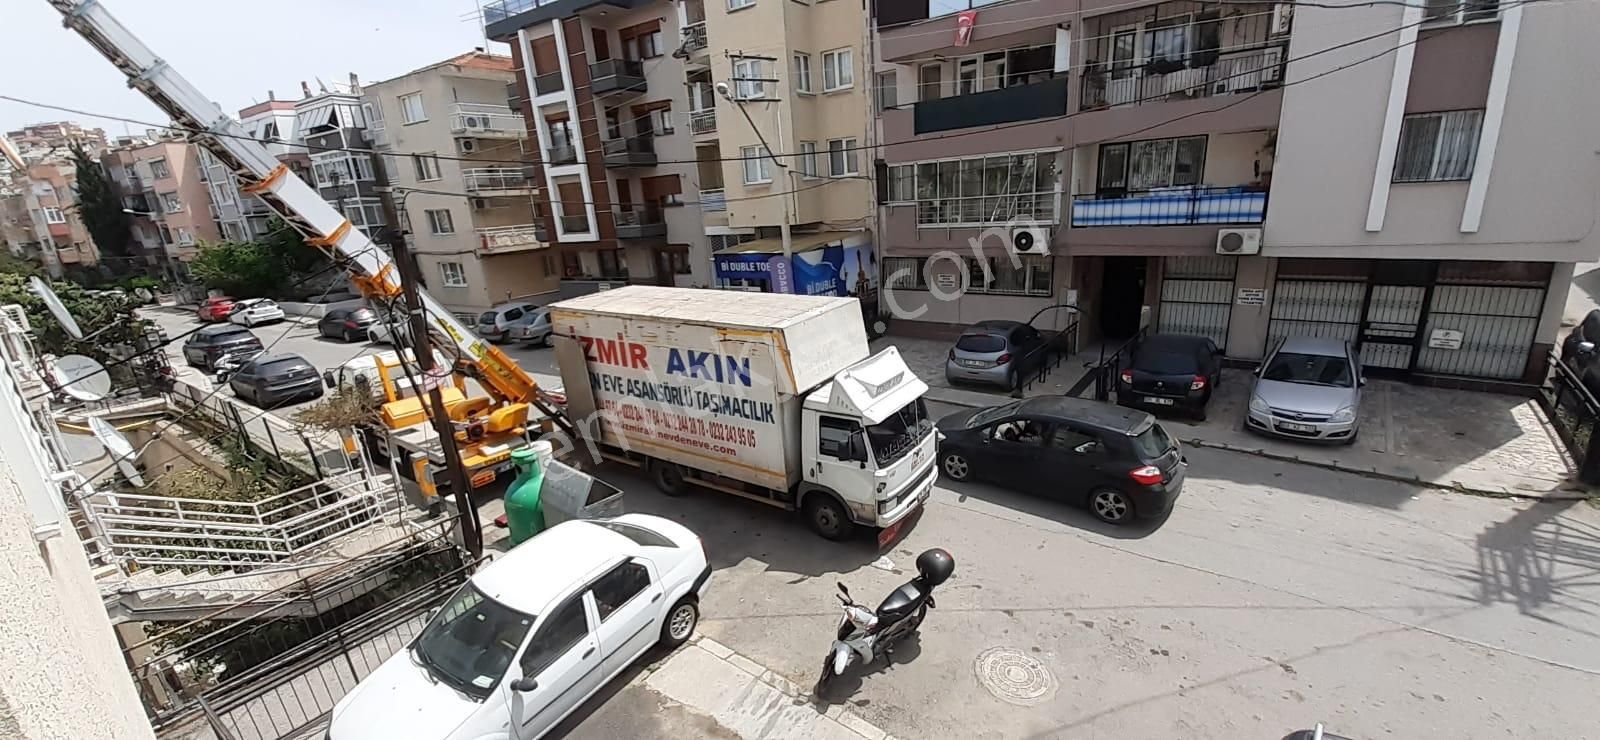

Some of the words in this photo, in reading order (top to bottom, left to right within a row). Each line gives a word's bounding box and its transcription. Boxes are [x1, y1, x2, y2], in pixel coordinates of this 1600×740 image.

[569, 325, 650, 371] ZMİR
[666, 347, 752, 387] AKIN
[602, 374, 625, 395] EVE
[627, 378, 693, 408] ASANSÖRLÜ
[694, 390, 775, 425] TAŞIMACILIK
[709, 420, 725, 441] 0232
[725, 424, 737, 444] 243
